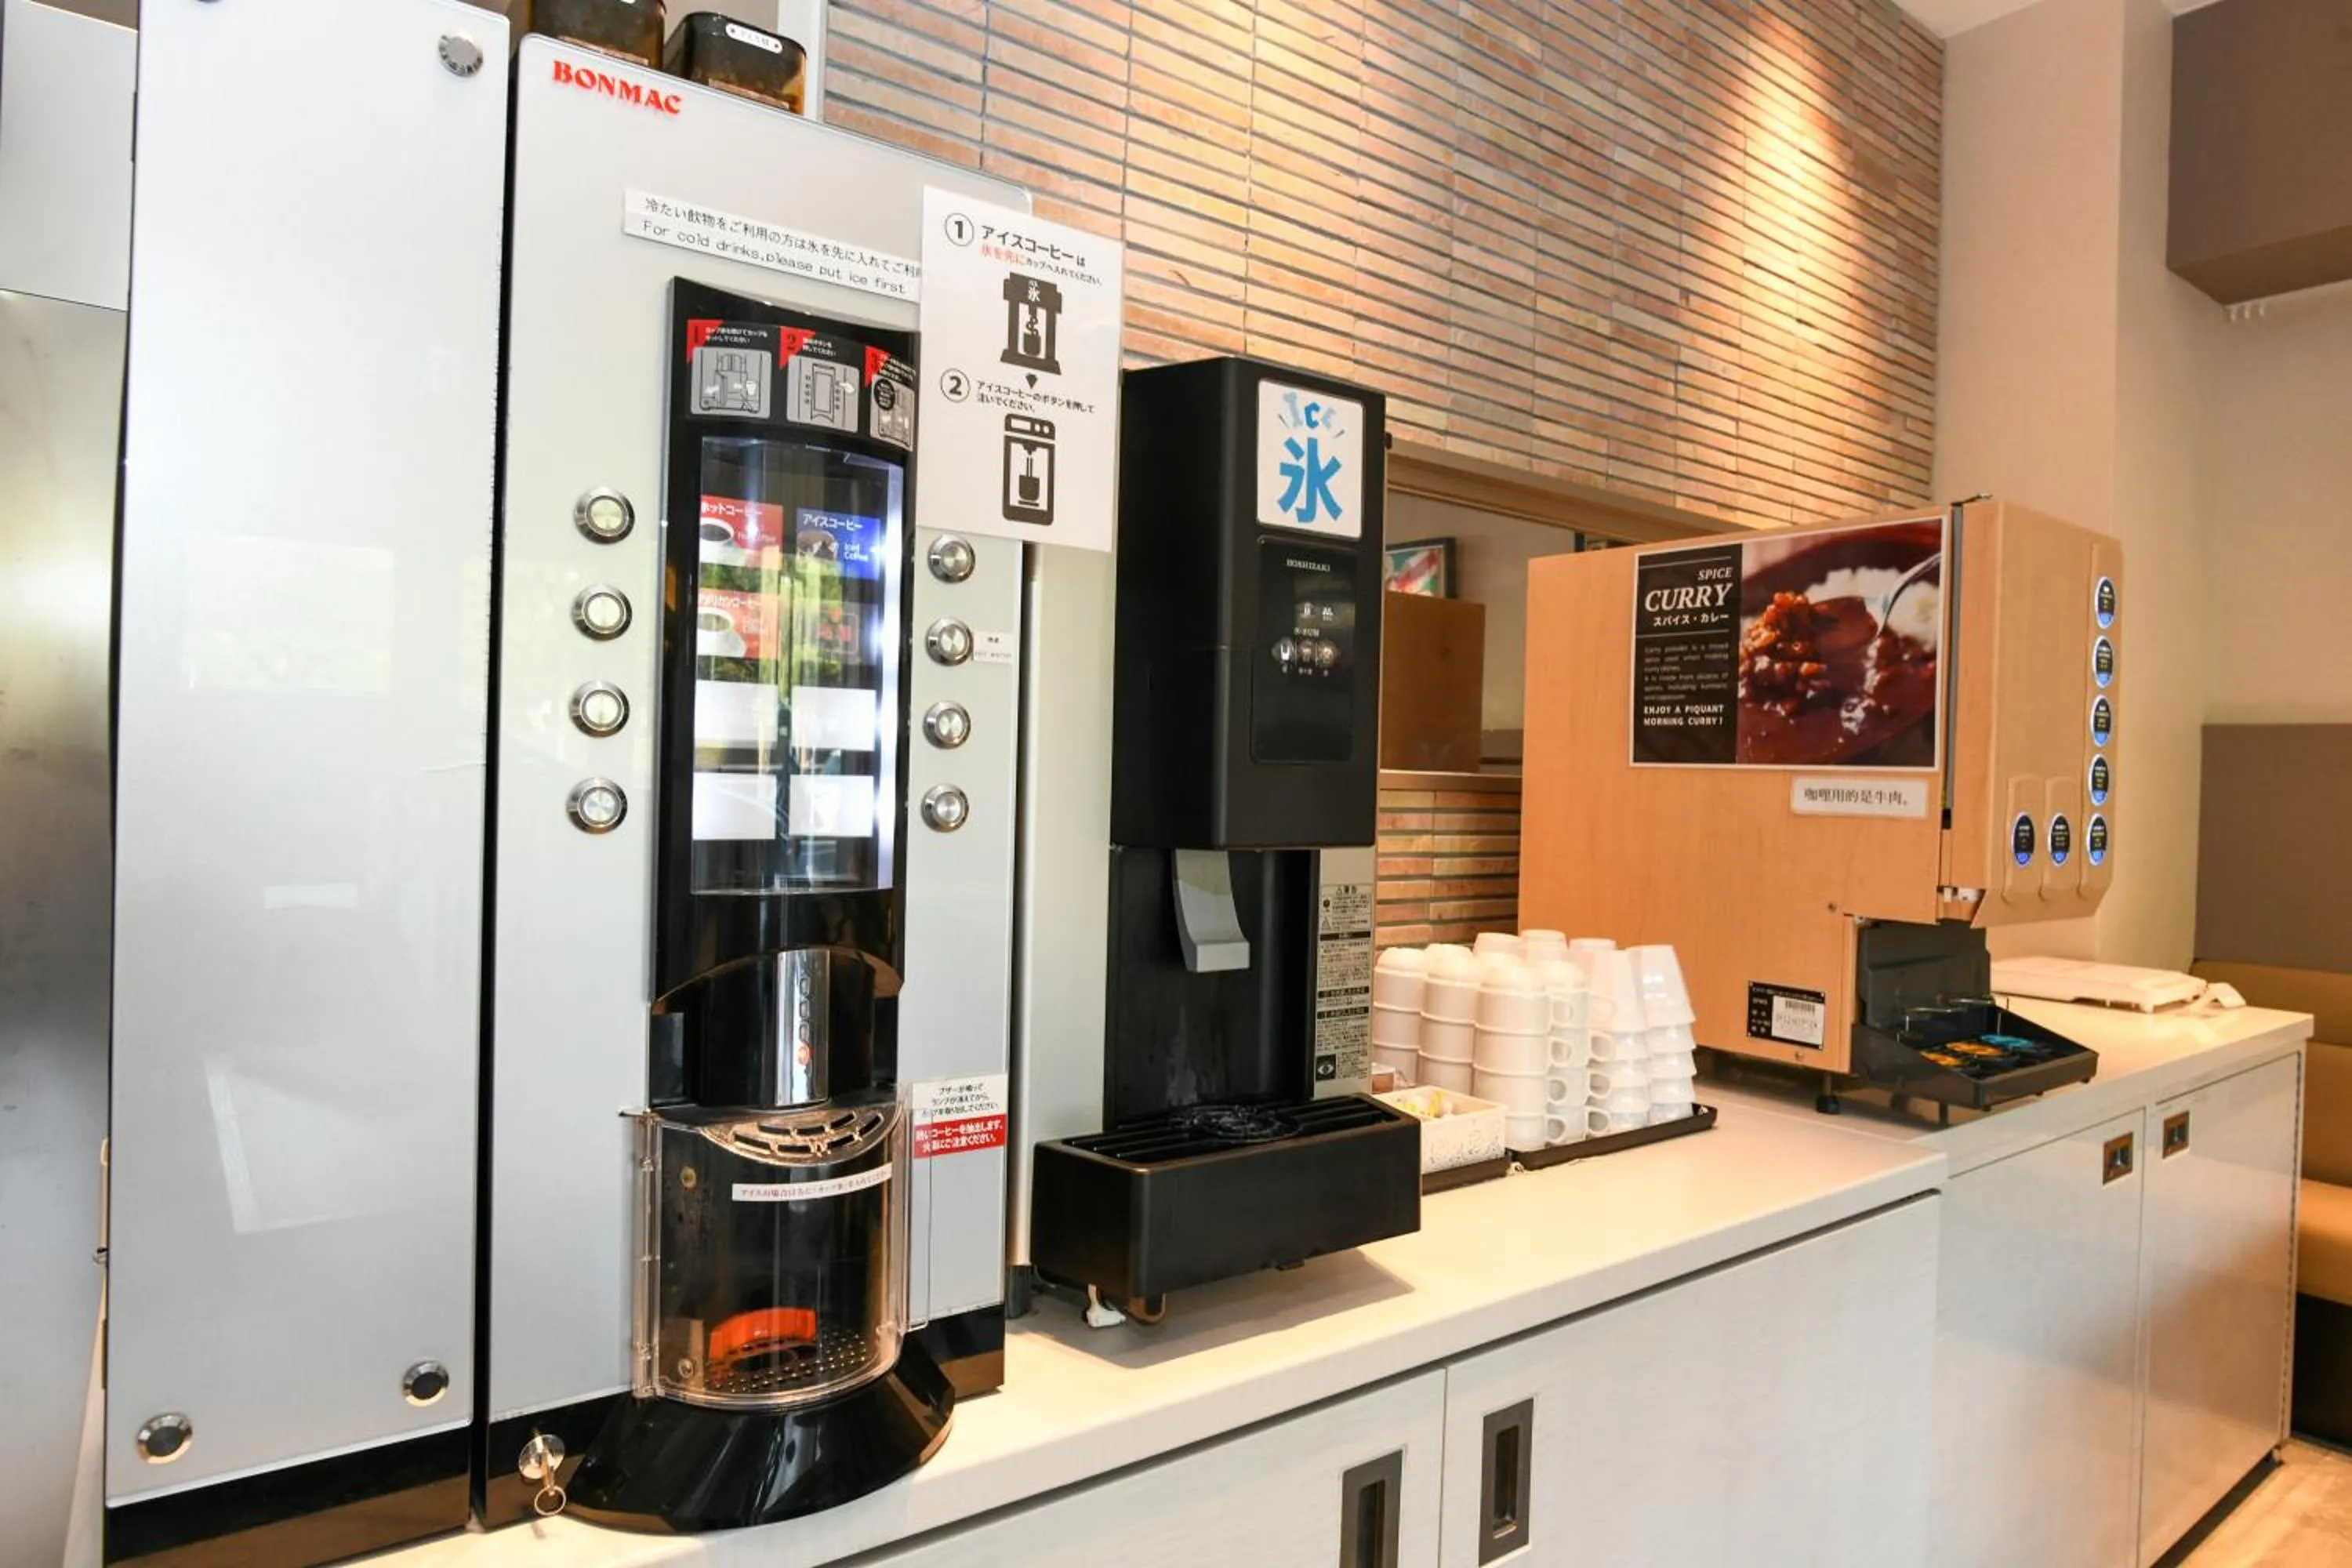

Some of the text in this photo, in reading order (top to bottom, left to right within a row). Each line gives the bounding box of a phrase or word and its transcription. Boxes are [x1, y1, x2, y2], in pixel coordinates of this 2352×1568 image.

[553, 60, 684, 114] BONMAC
[643, 220, 670, 236] For
[677, 231, 710, 247] cold
[818, 266, 843, 281] put
[849, 270, 868, 286] ice
[875, 277, 906, 295] first
[982, 225, 1087, 267] アイスコーヒーは
[1277, 437, 1343, 524] 氷
[803, 514, 863, 532] アイスコーヒー
[1697, 567, 1733, 581] SPICE
[1645, 583, 1733, 612] CURRY
[1653, 612, 1730, 626] スパイス・カレー
[1643, 703, 1724, 715] ENJOY A PIQUANT
[1643, 717, 1684, 726] MORNING
